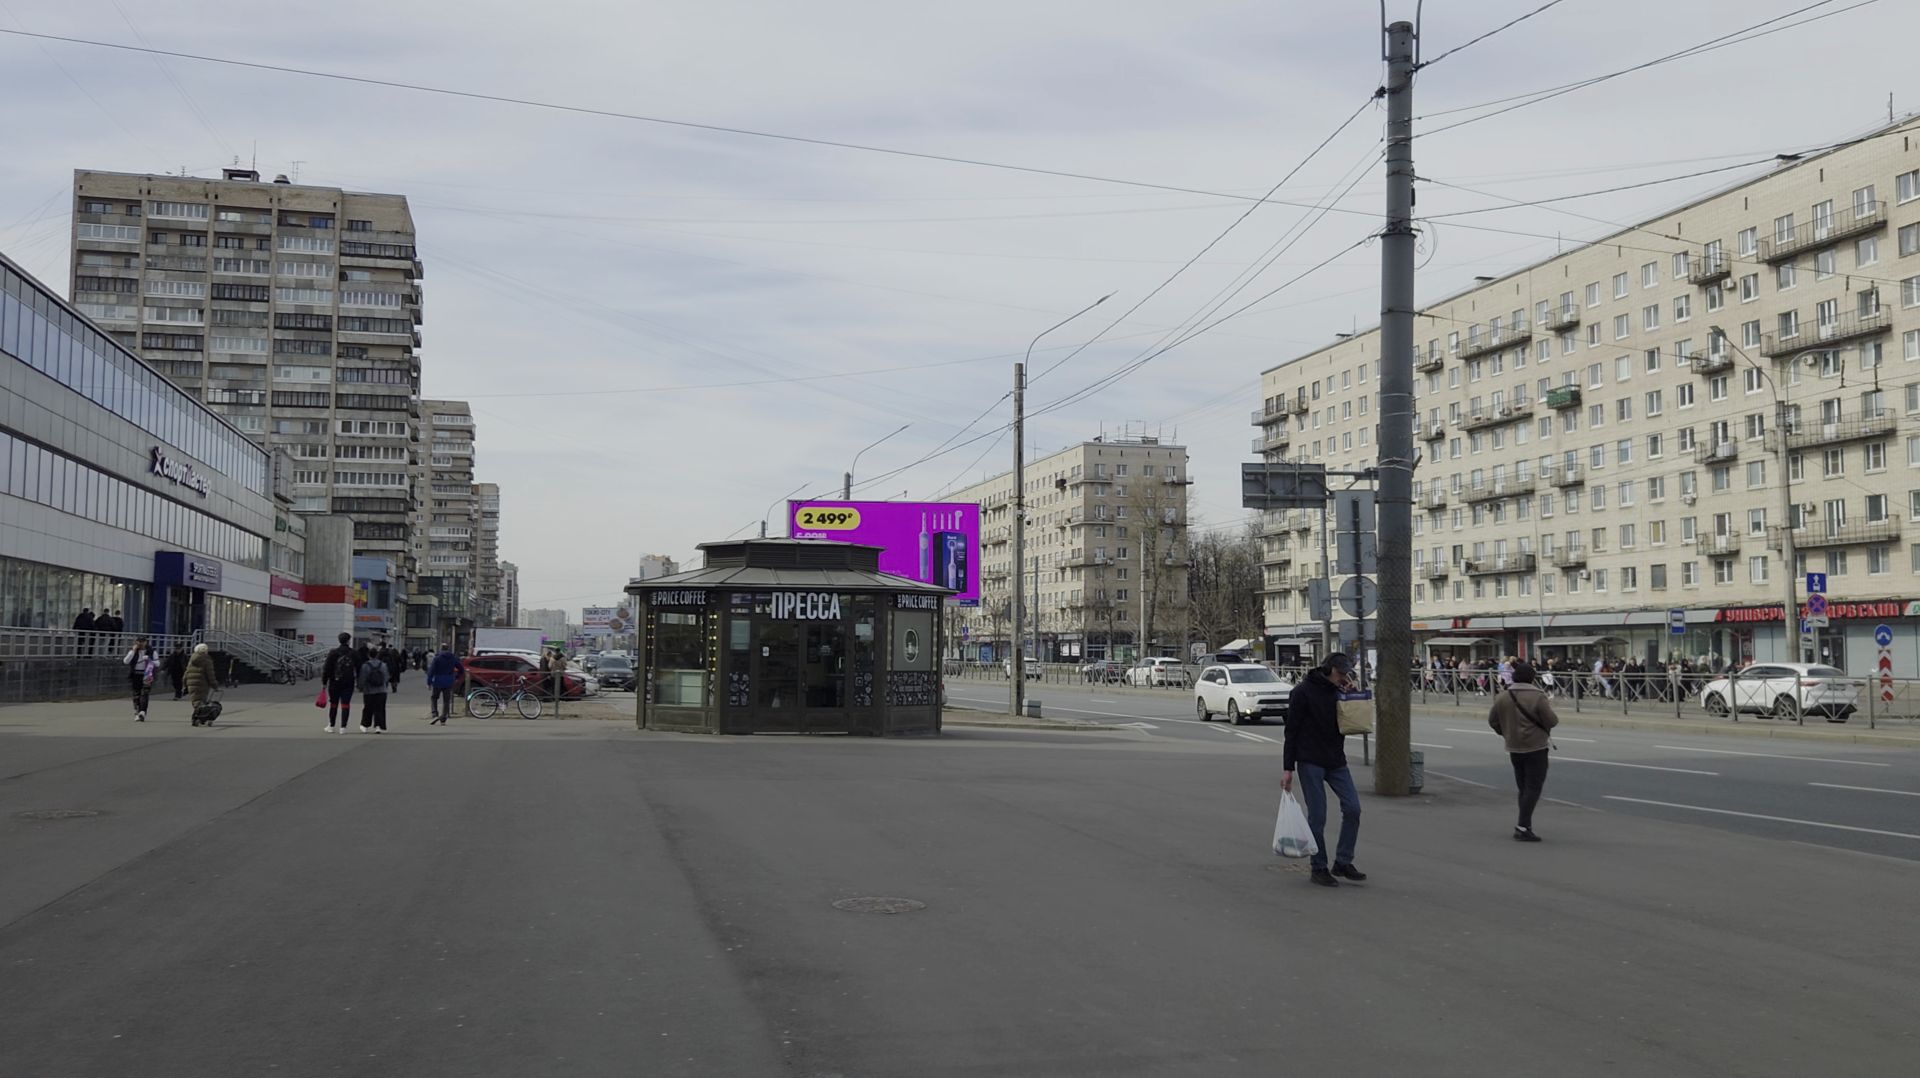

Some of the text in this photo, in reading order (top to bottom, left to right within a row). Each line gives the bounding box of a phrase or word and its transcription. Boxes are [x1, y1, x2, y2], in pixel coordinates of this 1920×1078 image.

[803, 512, 813, 524] 2
[657, 591, 679, 605] PRICE
[679, 591, 706, 605] COFFEE
[902, 594, 919, 609] PRICE
[918, 595, 938, 610] COFFEE
[771, 592, 841, 620] ПРЕССА
